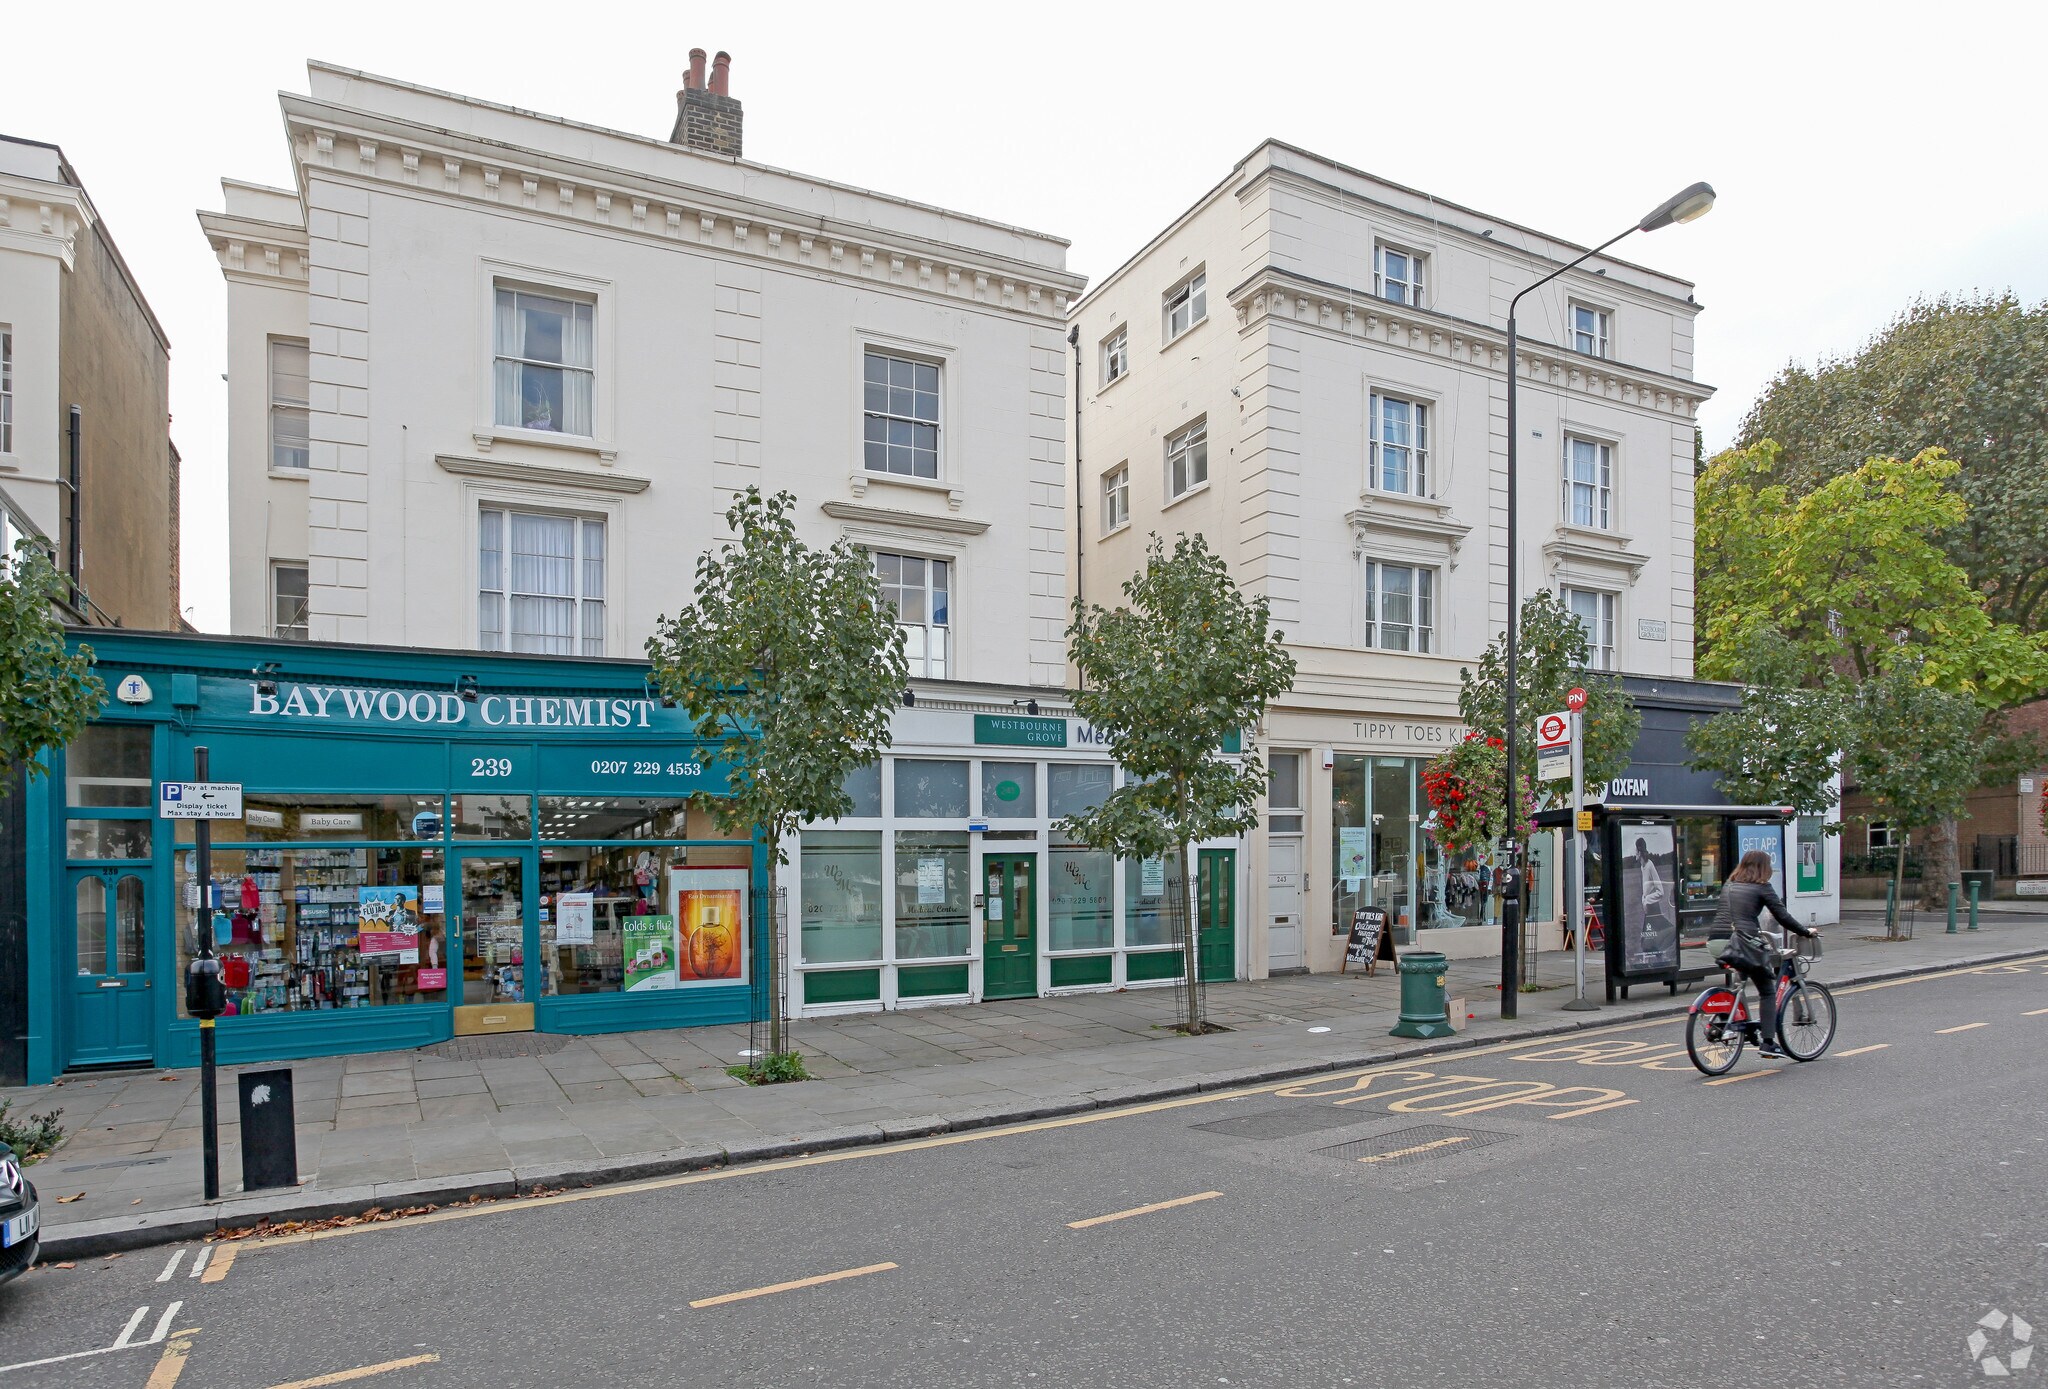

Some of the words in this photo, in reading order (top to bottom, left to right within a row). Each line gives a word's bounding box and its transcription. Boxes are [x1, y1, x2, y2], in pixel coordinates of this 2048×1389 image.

[249, 684, 466, 724] BAYWOOD
[480, 696, 655, 727] CHEMIST
[1568, 693, 1583, 704] PN
[991, 719, 1062, 732] WESTBOURNE
[1353, 722, 1396, 740] TIPPY
[1404, 725, 1442, 741] TOES
[1027, 732, 1062, 742] GROVE
[471, 757, 512, 776] 239
[591, 760, 628, 775] 0207
[633, 761, 661, 775] 229
[666, 763, 701, 776] 4553
[167, 785, 180, 800] P
[1612, 778, 1649, 796] OXFAM
[248, 814, 262, 823] Baby
[262, 816, 276, 824] Care
[311, 818, 331, 826] Baby
[332, 818, 351, 826] Care
[1742, 837, 1759, 852] GET
[1760, 837, 1777, 851] APP
[363, 907, 374, 915] FLU
[936, 904, 957, 913] Centre
[623, 920, 646, 931] Colds
[649, 922, 654, 931] &
[656, 919, 672, 931] flu?
[1274, 1071, 1641, 1120] STOP
